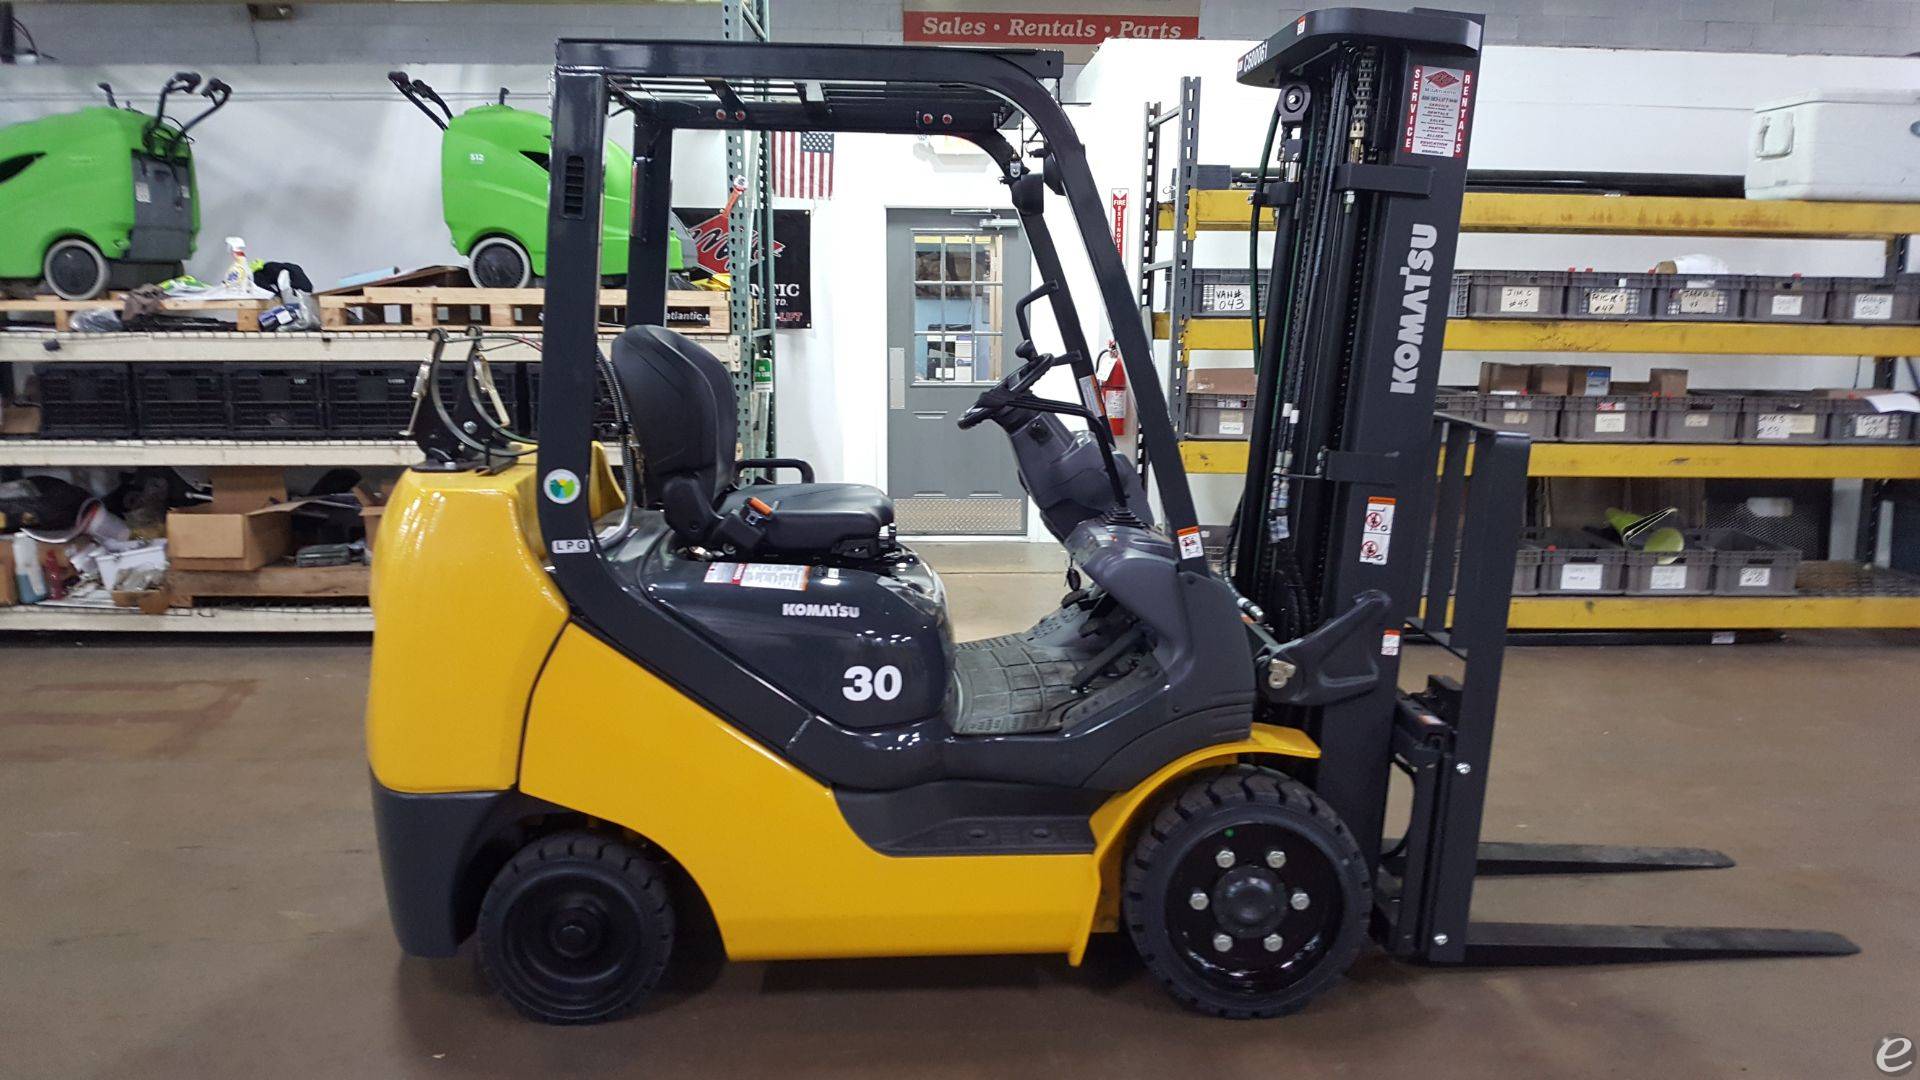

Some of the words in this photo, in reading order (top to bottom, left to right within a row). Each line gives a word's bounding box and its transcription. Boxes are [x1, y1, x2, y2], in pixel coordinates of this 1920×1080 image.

[922, 17, 986, 36] Sales
[1008, 18, 1097, 39] Rentals
[1117, 20, 1183, 40] Parts
[1405, 68, 1421, 148] SERVICE
[1455, 74, 1472, 153] RENTALS
[1216, 289, 1242, 299] VAN#
[1220, 298, 1245, 310] 043
[1390, 223, 1438, 394] KOMATSU
[556, 540, 586, 551] LPG
[782, 602, 861, 618] KOMATSU
[842, 665, 903, 702] 30
